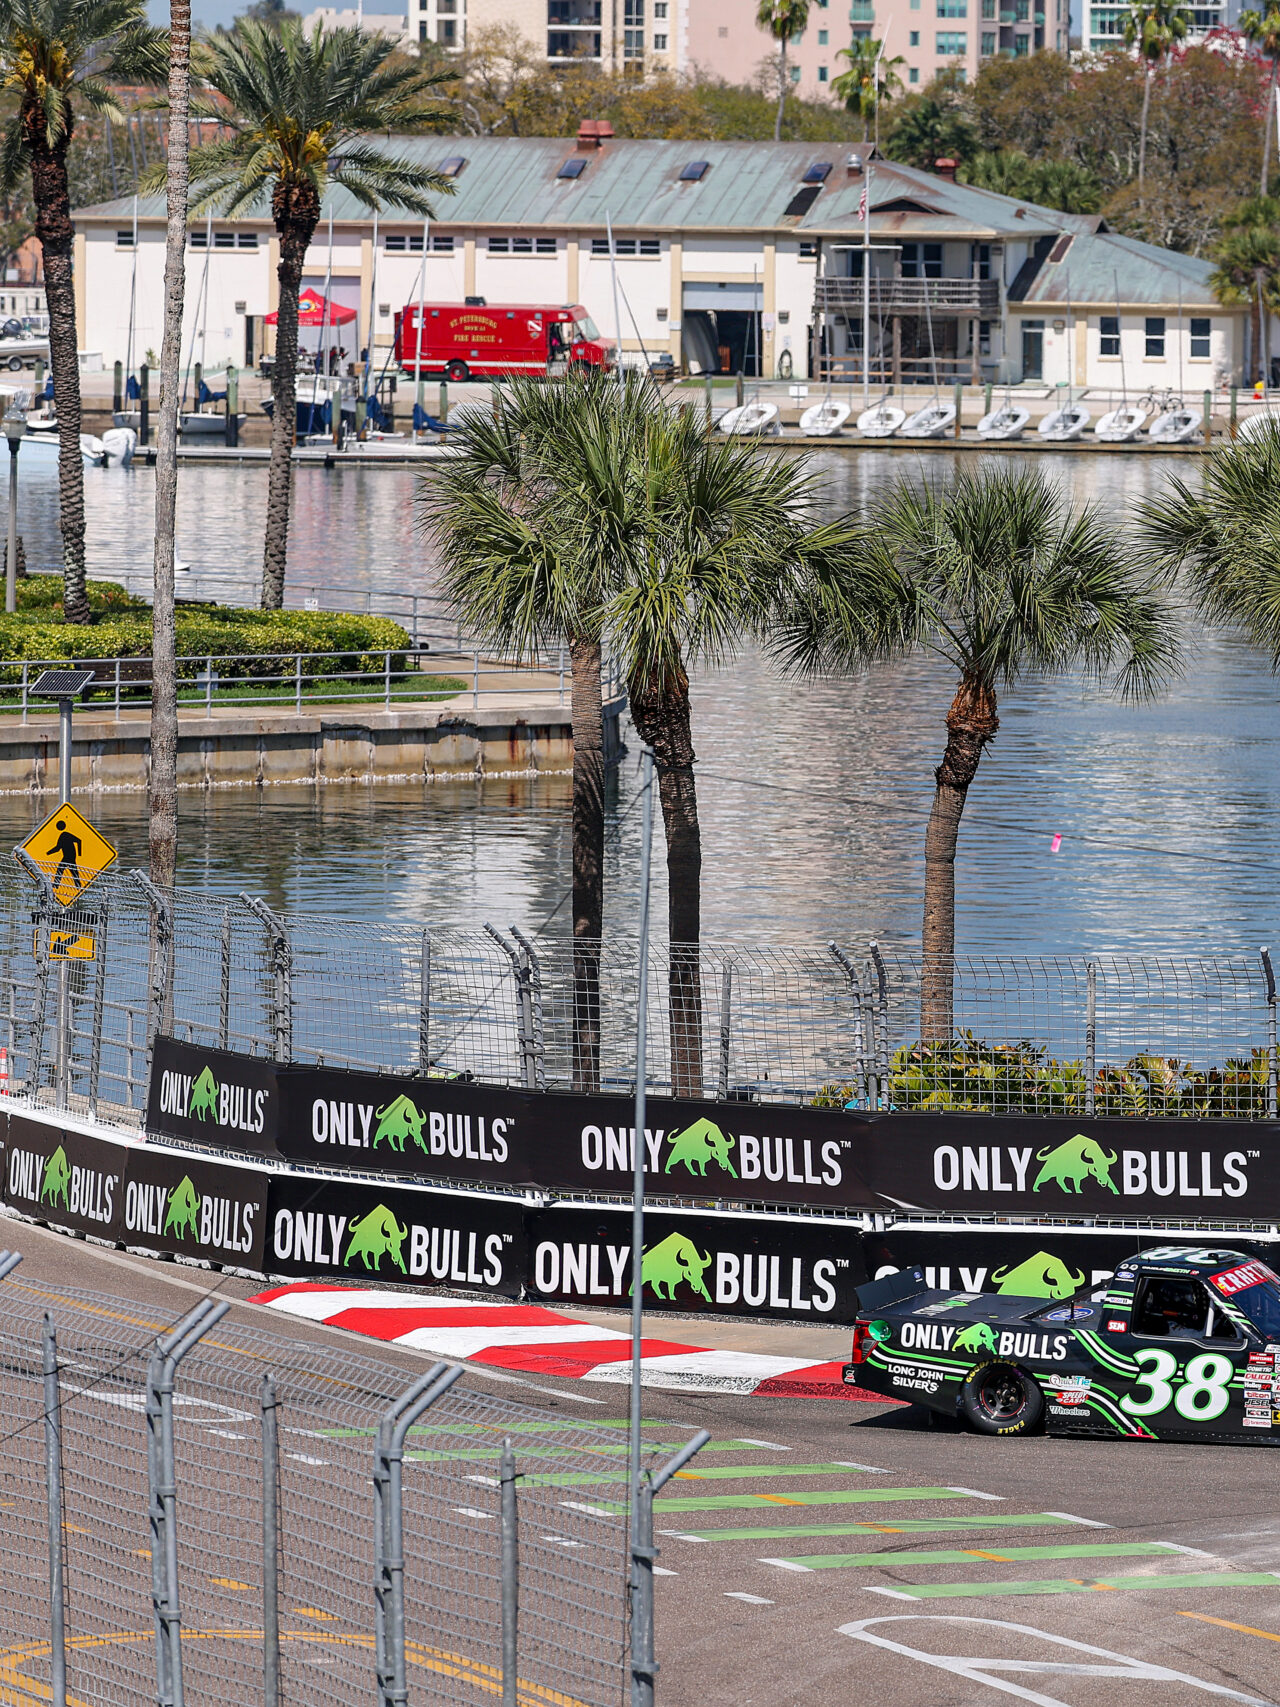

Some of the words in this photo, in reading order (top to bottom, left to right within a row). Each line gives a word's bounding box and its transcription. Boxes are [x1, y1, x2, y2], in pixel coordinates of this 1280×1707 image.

[160, 1069, 191, 1117] ONLY
[312, 1098, 373, 1148] ONLY
[581, 1125, 664, 1173] ONLY
[934, 1145, 1033, 1192] ONLY
[10, 1147, 44, 1202] ONLY
[125, 1180, 167, 1235] ONLY
[273, 1208, 347, 1266] ONLY
[535, 1241, 631, 1296] ONLY
[901, 1322, 956, 1351] ONLY
[1108, 1321, 1126, 1331] SEM
[888, 1364, 916, 1376] LONG
[917, 1369, 944, 1381] JOHN
[1118, 1348, 1234, 1422] 38
[996, 1419, 1026, 1435] EAGLE
[1049, 1405, 1091, 1417] Wheelers
